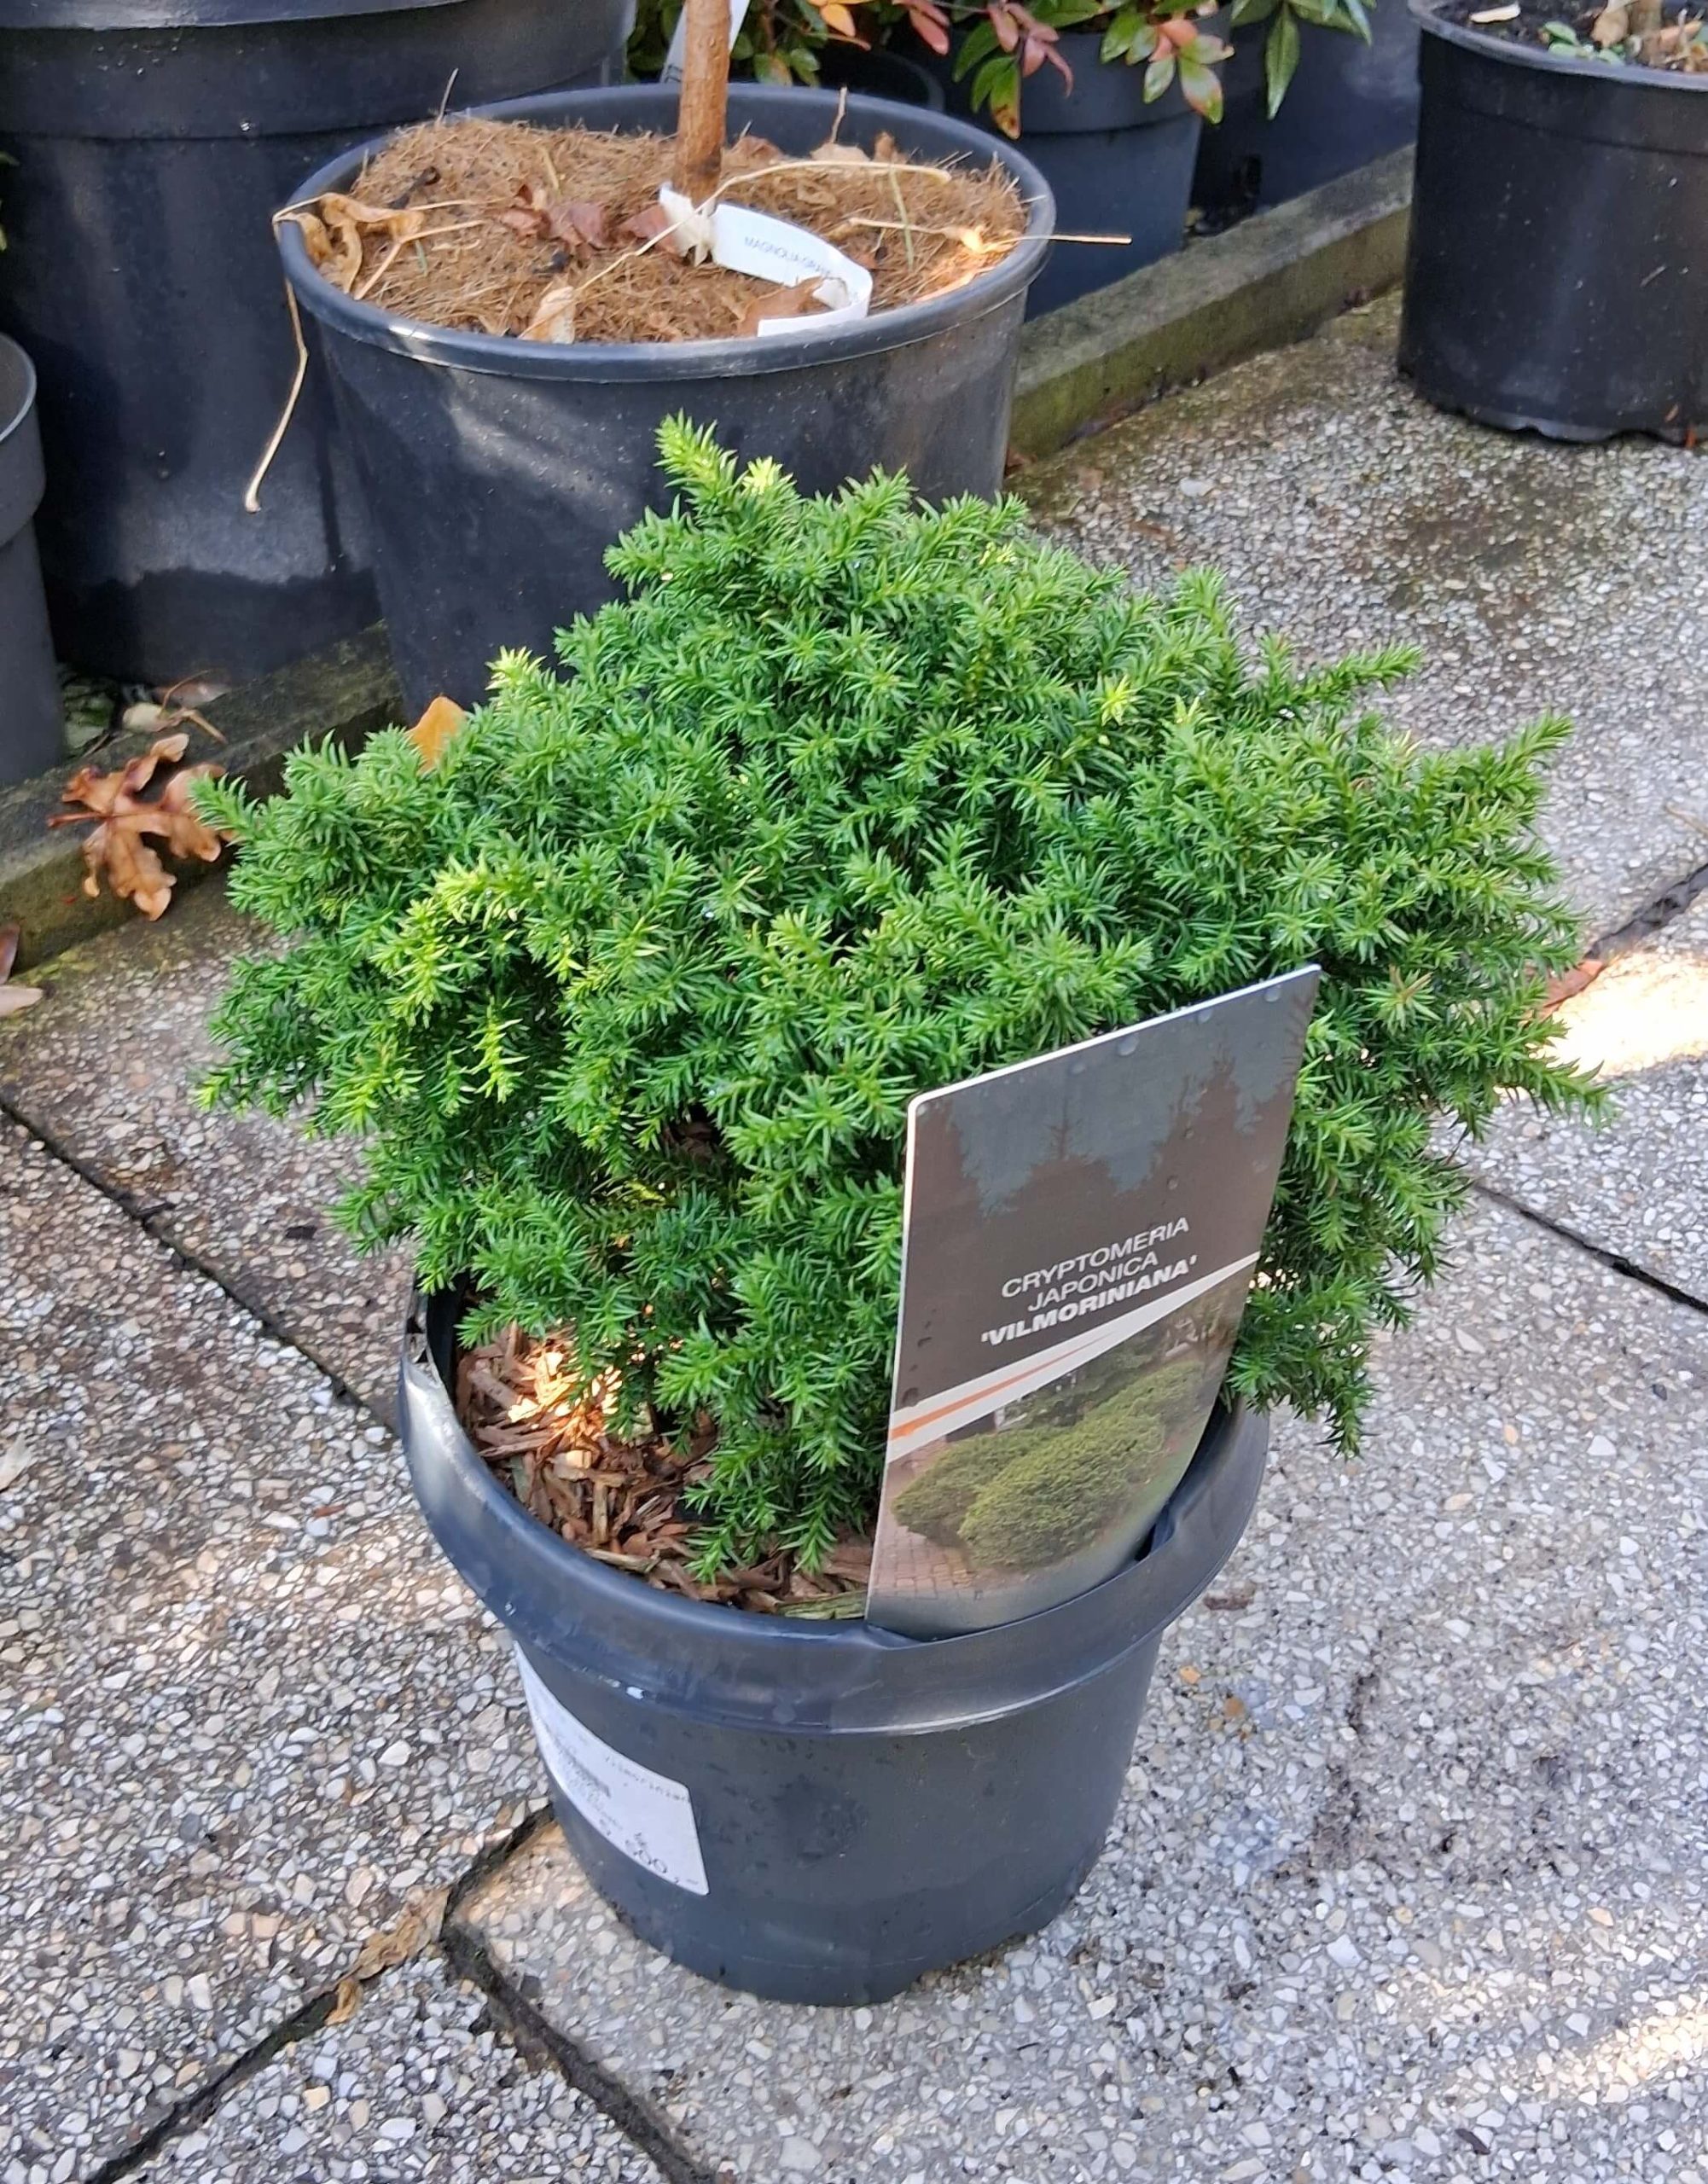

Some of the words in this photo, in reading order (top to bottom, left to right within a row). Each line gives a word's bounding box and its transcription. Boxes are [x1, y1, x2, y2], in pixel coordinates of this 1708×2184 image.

[1002, 1217, 1189, 1298] CRYPTOMERIA
[1028, 1251, 1159, 1312] JAPONICA
[980, 1254, 1198, 1346] 'VILMORINIANA'
